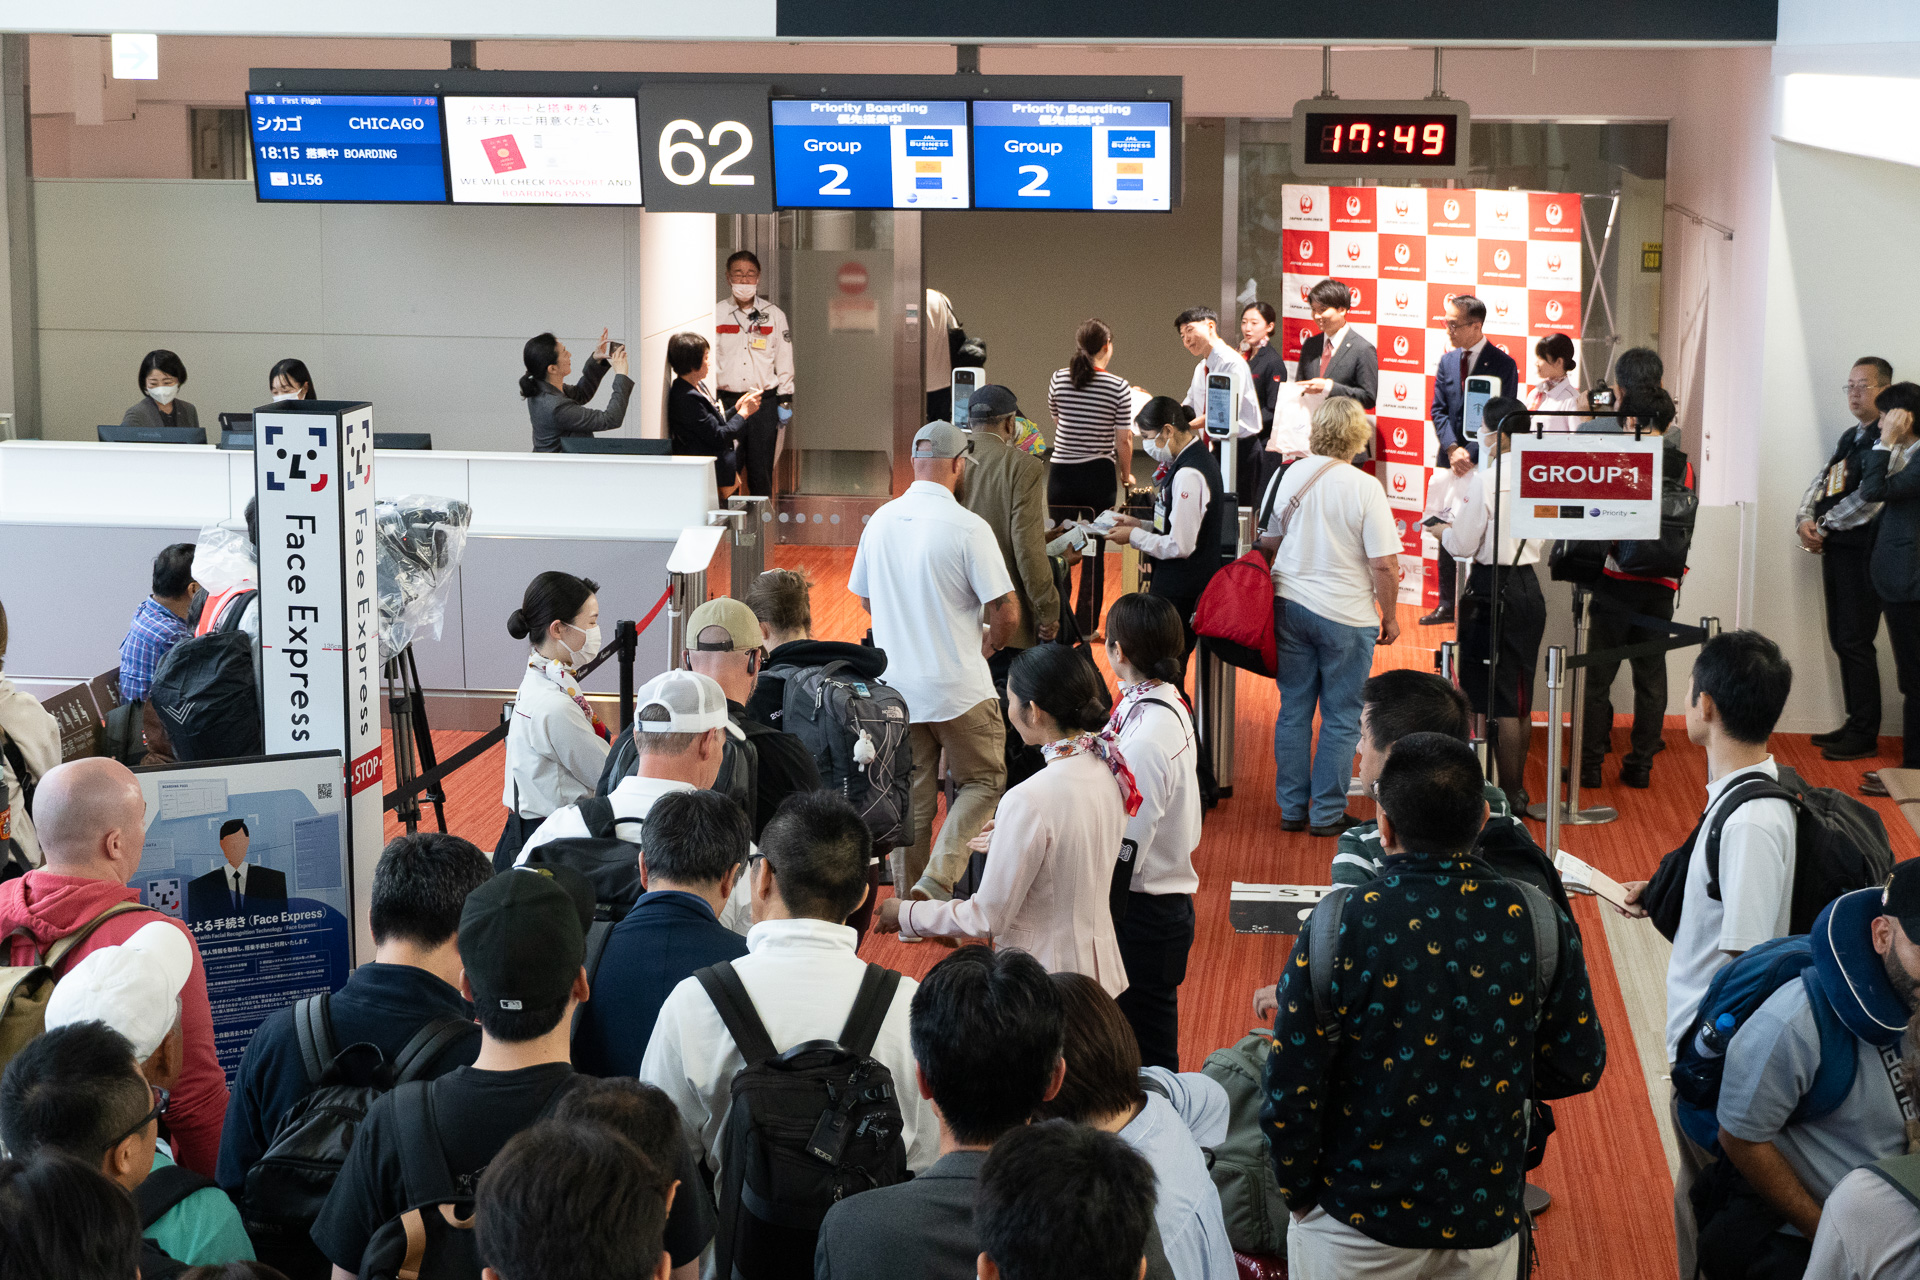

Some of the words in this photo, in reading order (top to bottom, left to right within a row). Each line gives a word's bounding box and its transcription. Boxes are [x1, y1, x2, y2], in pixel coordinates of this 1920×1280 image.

[300, 97, 322, 105] Flight
[811, 103, 861, 114] Priority
[865, 103, 928, 115] Boarding
[1012, 104, 1064, 115] Priority
[1067, 104, 1132, 116] Boarding
[257, 116, 302, 131] シカゴ
[348, 117, 424, 130] CHICAGO
[466, 116, 610, 126] お手元にご用意ください
[803, 138, 862, 154] Group
[1332, 122, 1446, 156] 17:49
[260, 146, 300, 159] 18:15
[305, 148, 339, 159] 搭乗中
[343, 149, 398, 159] BOARDING
[658, 118, 756, 186] 62
[1004, 139, 1063, 156] Group
[289, 173, 323, 186] JL56
[460, 178, 478, 186] WE
[481, 178, 507, 186] WILL
[510, 178, 546, 186] CHECK
[548, 179, 604, 187] PASSPORT
[818, 163, 852, 196] 2
[1017, 164, 1051, 197] 2
[502, 190, 562, 198] BOARDING
[565, 190, 592, 198] PASS
[1528, 464, 1622, 484] GROUP
[1628, 466, 1639, 484] 1
[1602, 509, 1628, 517] Priority
[285, 514, 316, 594] Face
[355, 508, 368, 589] Face
[1402, 564, 1432, 577] NEC
[281, 605, 319, 742] Express
[356, 597, 370, 736] Express
[355, 755, 379, 785] STOP
[212, 932, 227, 940] Facial
[226, 930, 256, 938] Recognition
[256, 926, 283, 936] Technology
